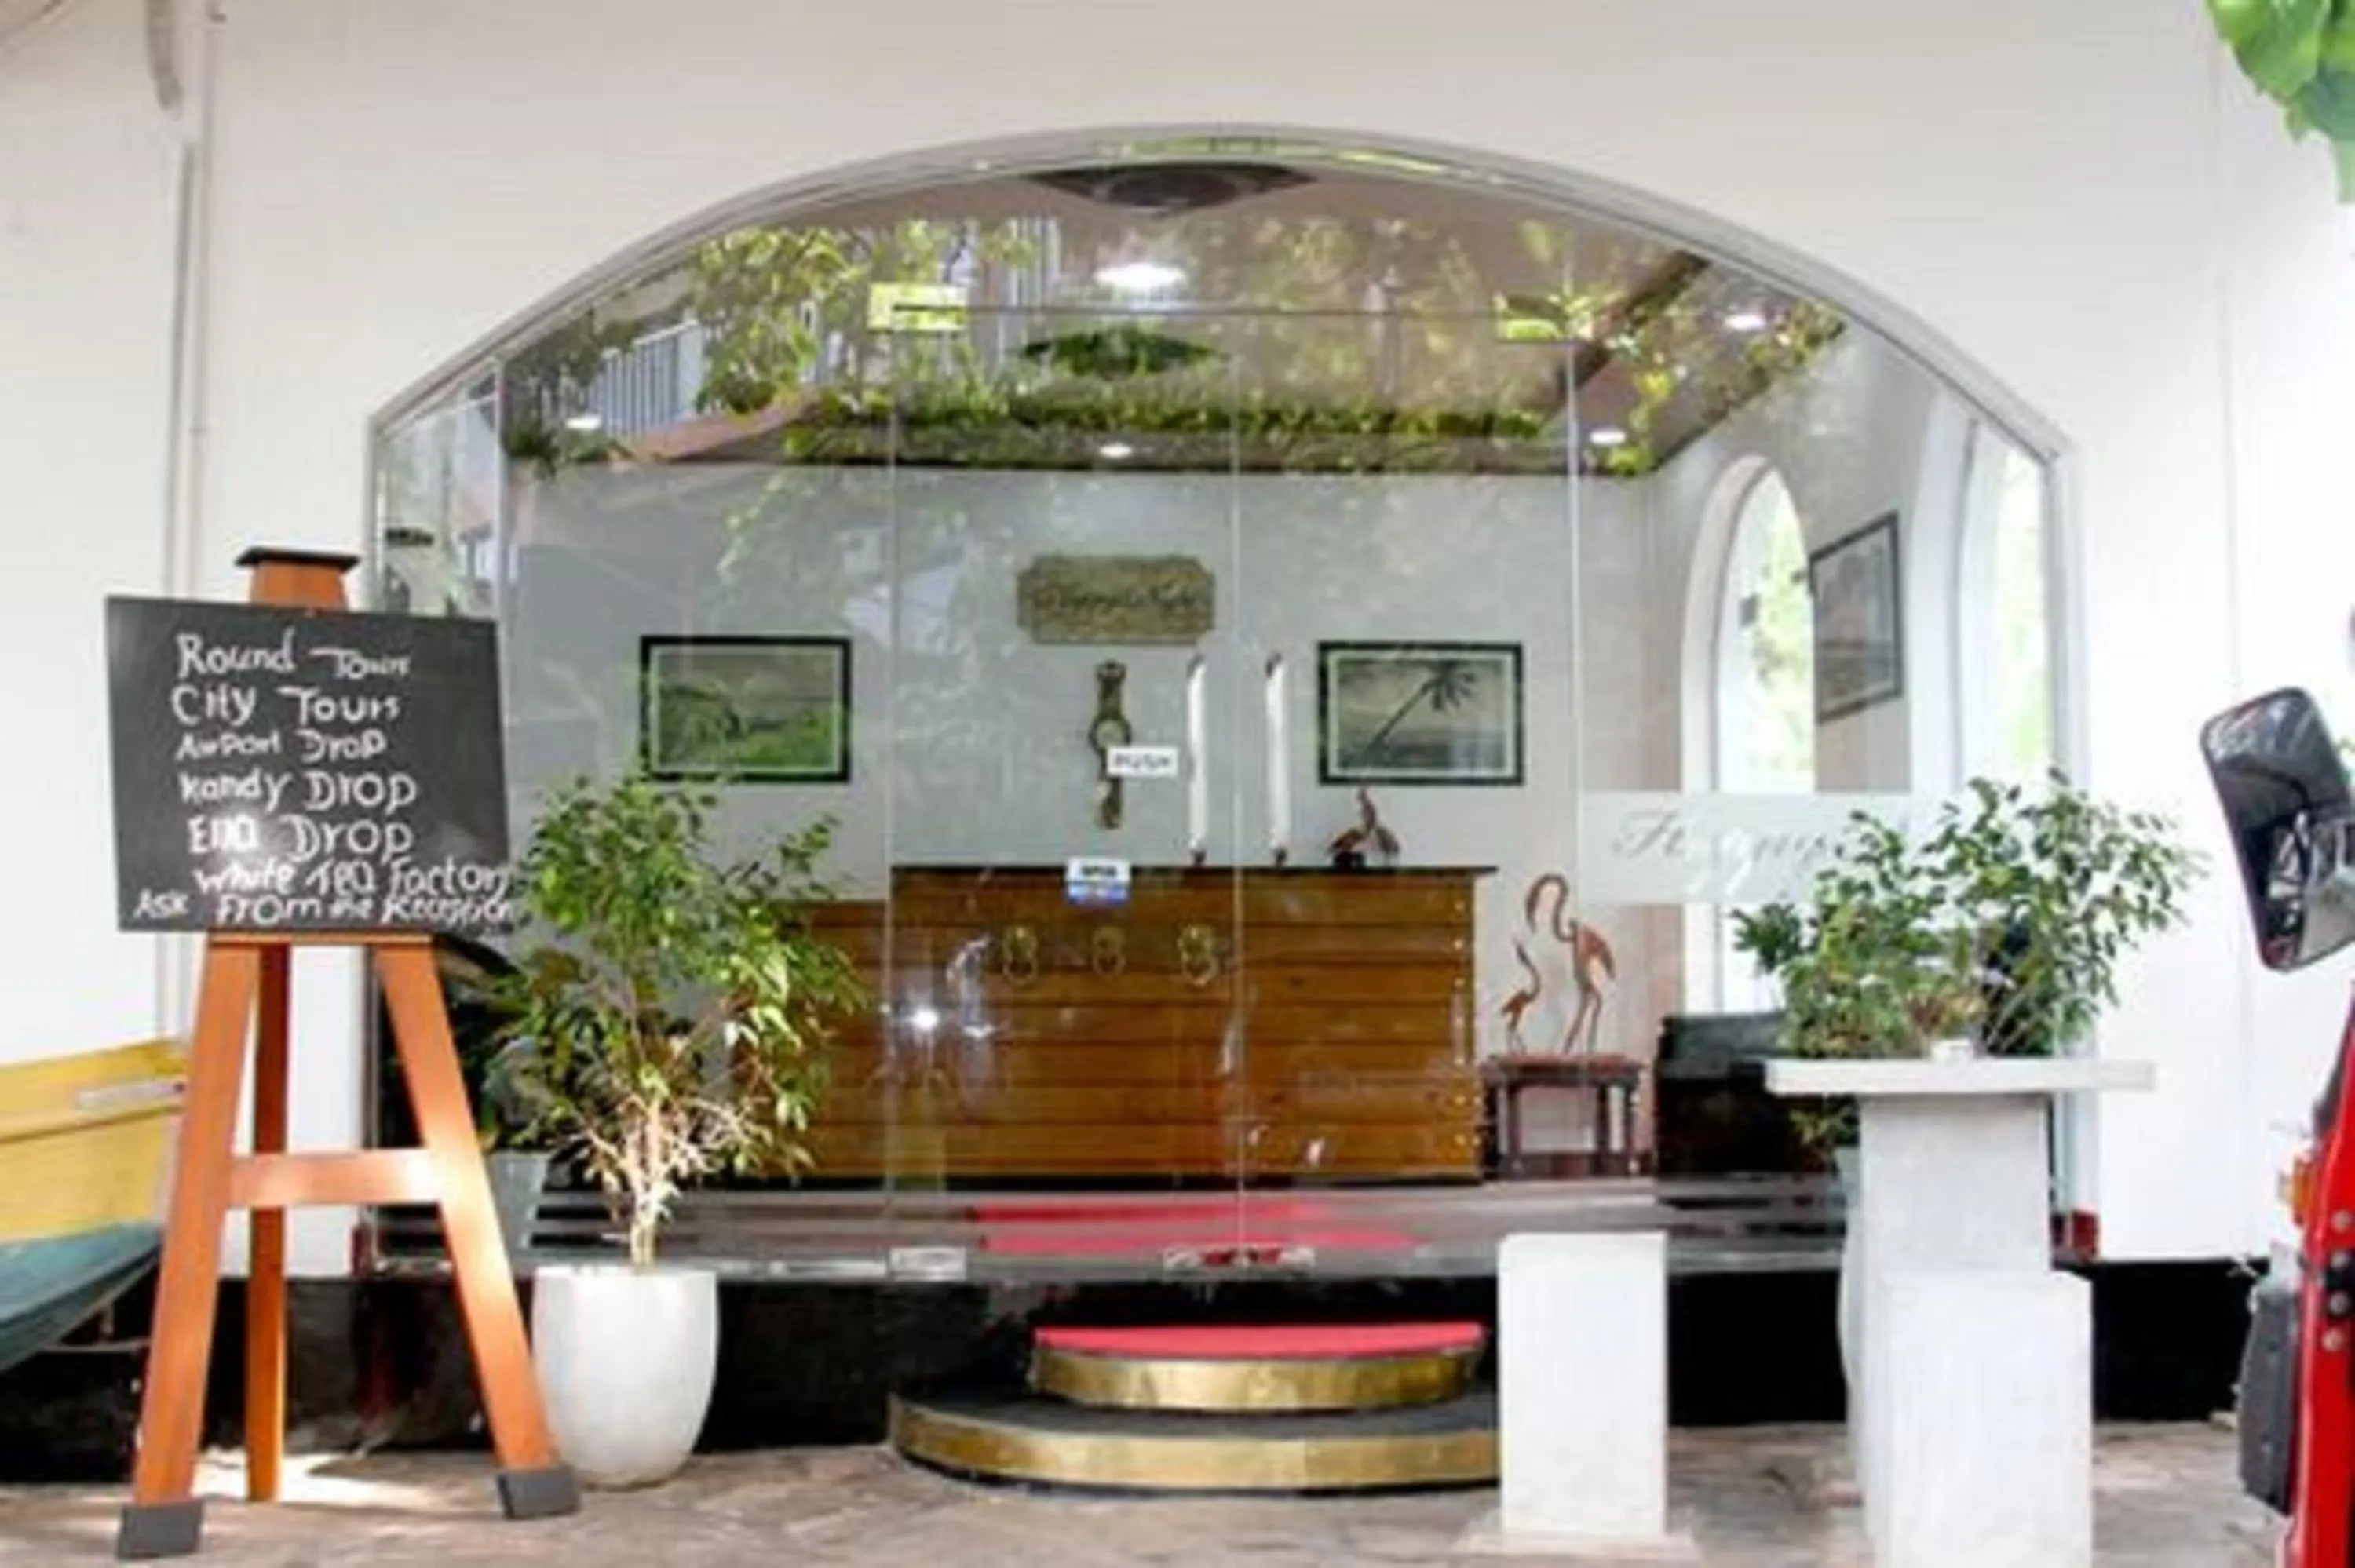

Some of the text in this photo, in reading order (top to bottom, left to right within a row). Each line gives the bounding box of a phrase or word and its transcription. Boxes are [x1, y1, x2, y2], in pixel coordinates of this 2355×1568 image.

[176, 627, 296, 680] Round
[171, 682, 401, 727] City Tours
[303, 770, 417, 815] Drop
[277, 813, 414, 862] Drop
